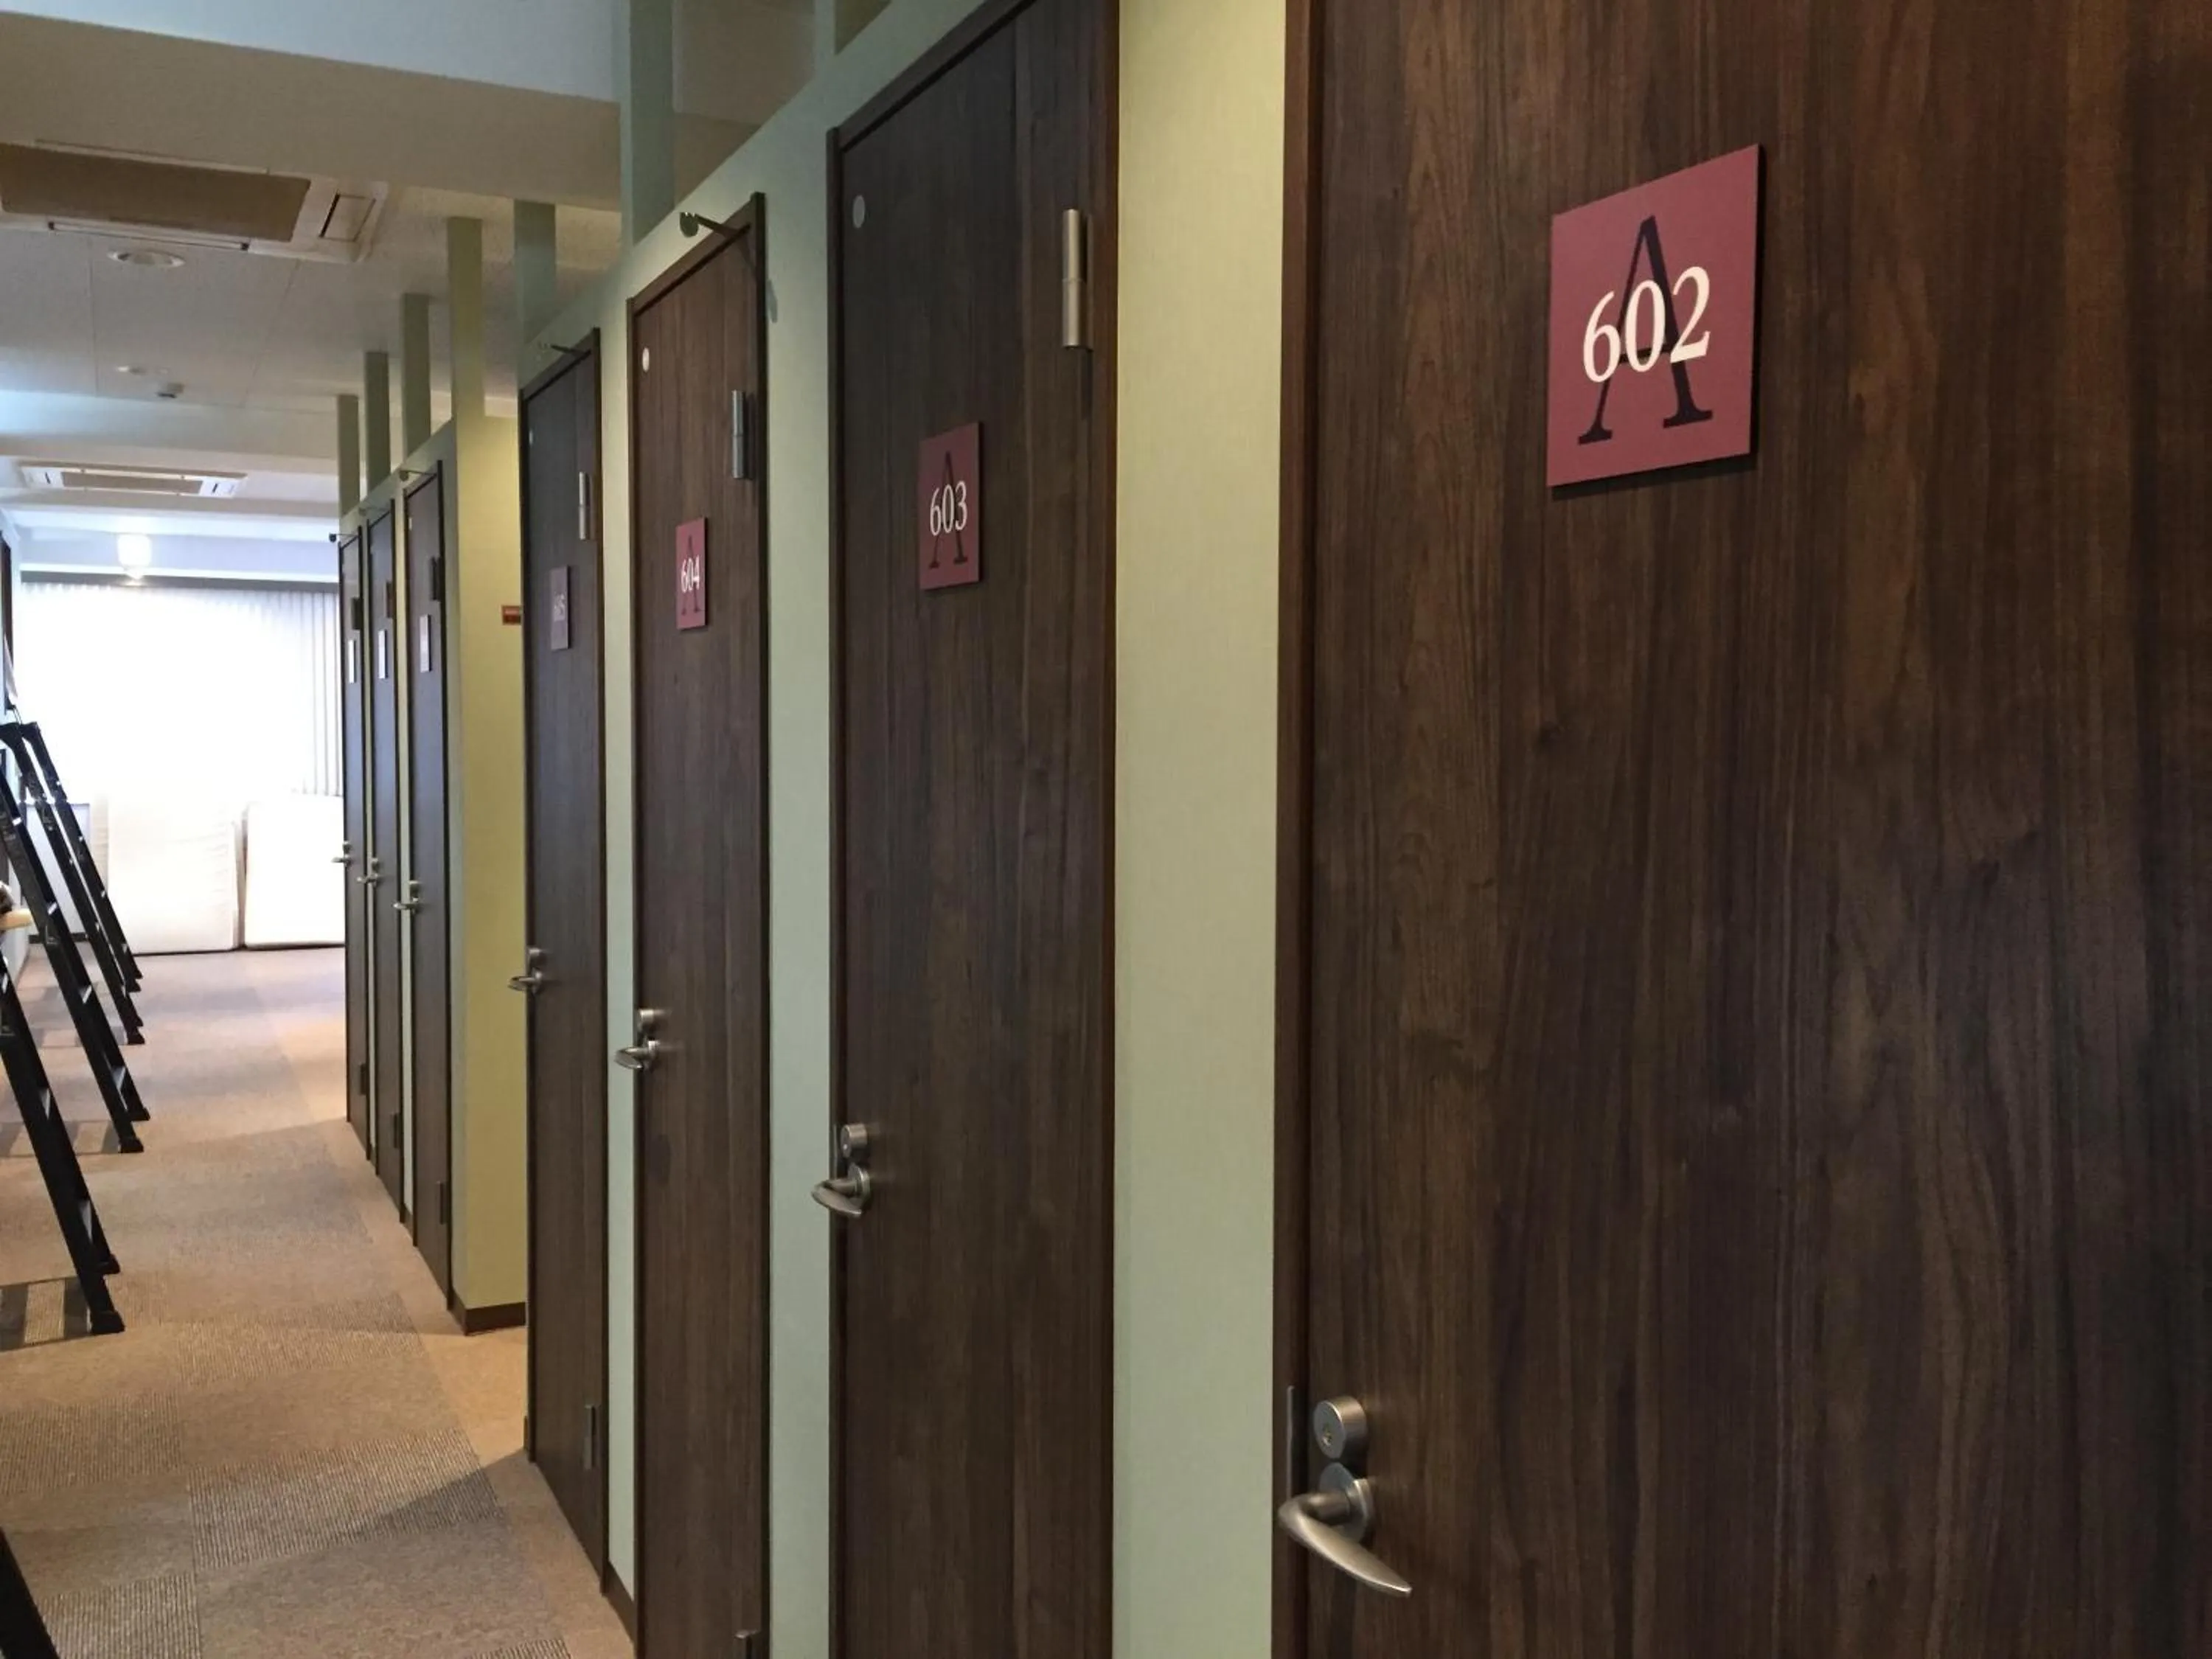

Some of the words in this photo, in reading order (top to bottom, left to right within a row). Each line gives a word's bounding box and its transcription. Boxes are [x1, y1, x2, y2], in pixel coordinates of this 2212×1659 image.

[1577, 215, 1713, 445] A
[1583, 266, 1711, 383] 602
[928, 451, 968, 569] A
[929, 481, 968, 536] 603
[681, 554, 700, 593] 604
